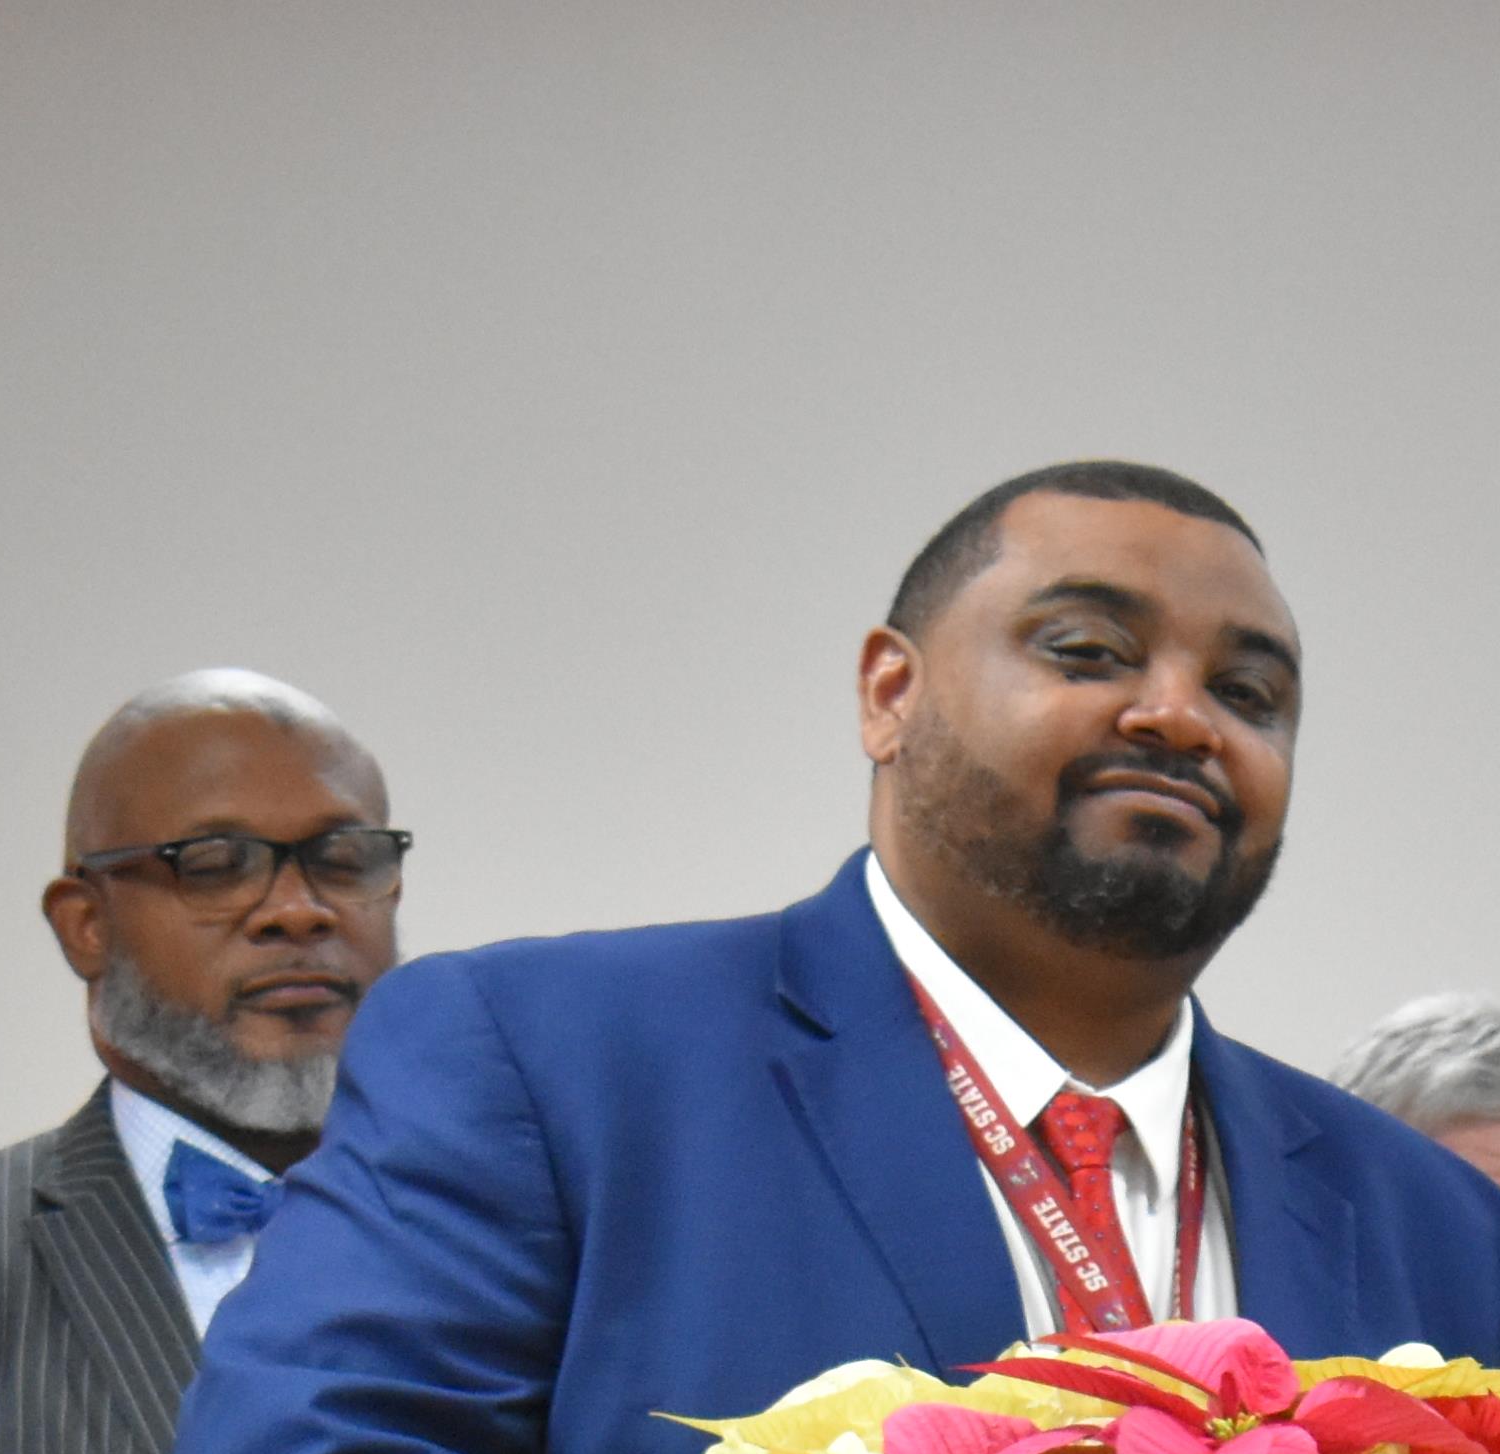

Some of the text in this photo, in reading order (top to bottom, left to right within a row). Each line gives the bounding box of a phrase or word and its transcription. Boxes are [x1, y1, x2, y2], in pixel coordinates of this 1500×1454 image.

[948, 1065, 1016, 1157] SC STATE
[1031, 1197, 1109, 1294] SC STATE
